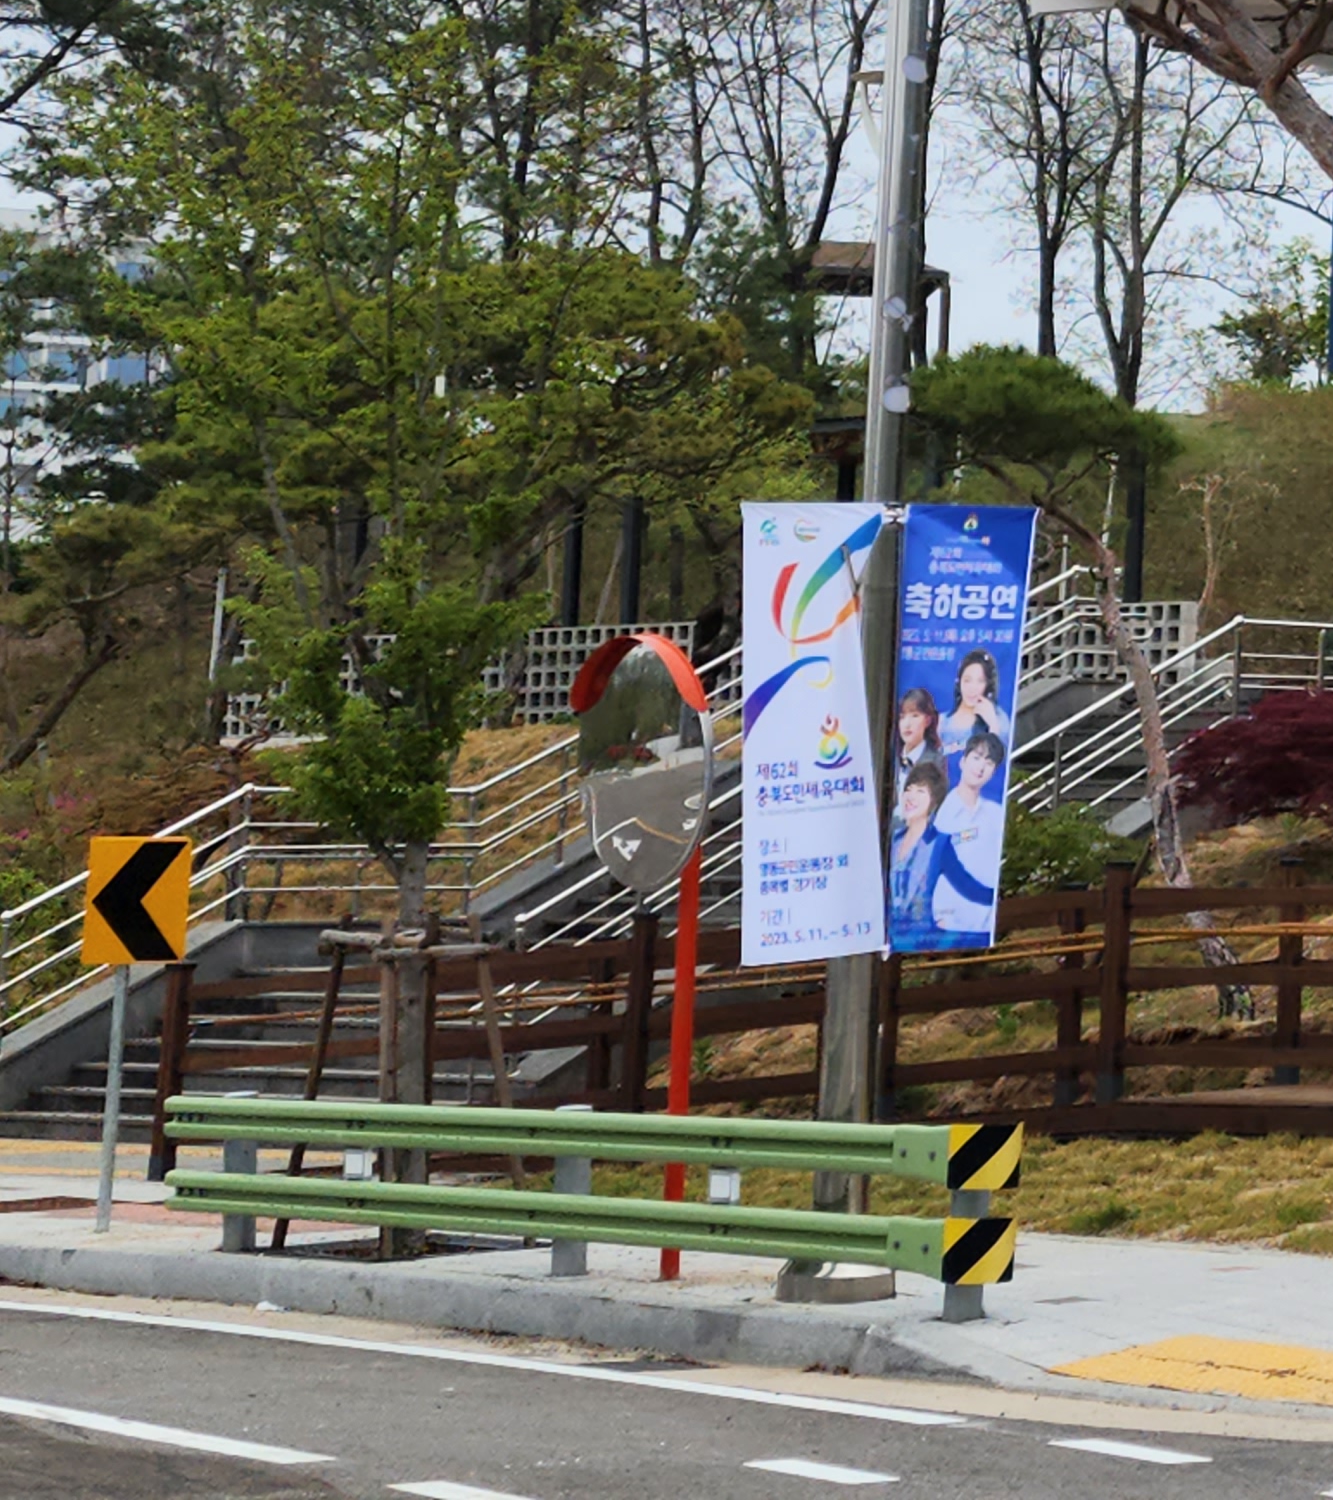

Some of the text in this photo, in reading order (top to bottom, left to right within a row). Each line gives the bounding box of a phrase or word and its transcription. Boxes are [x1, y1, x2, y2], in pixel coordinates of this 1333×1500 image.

[904, 582, 1019, 620] 축하공연
[756, 760, 798, 780] 제62회
[756, 775, 865, 807] 충북도민체육대회
